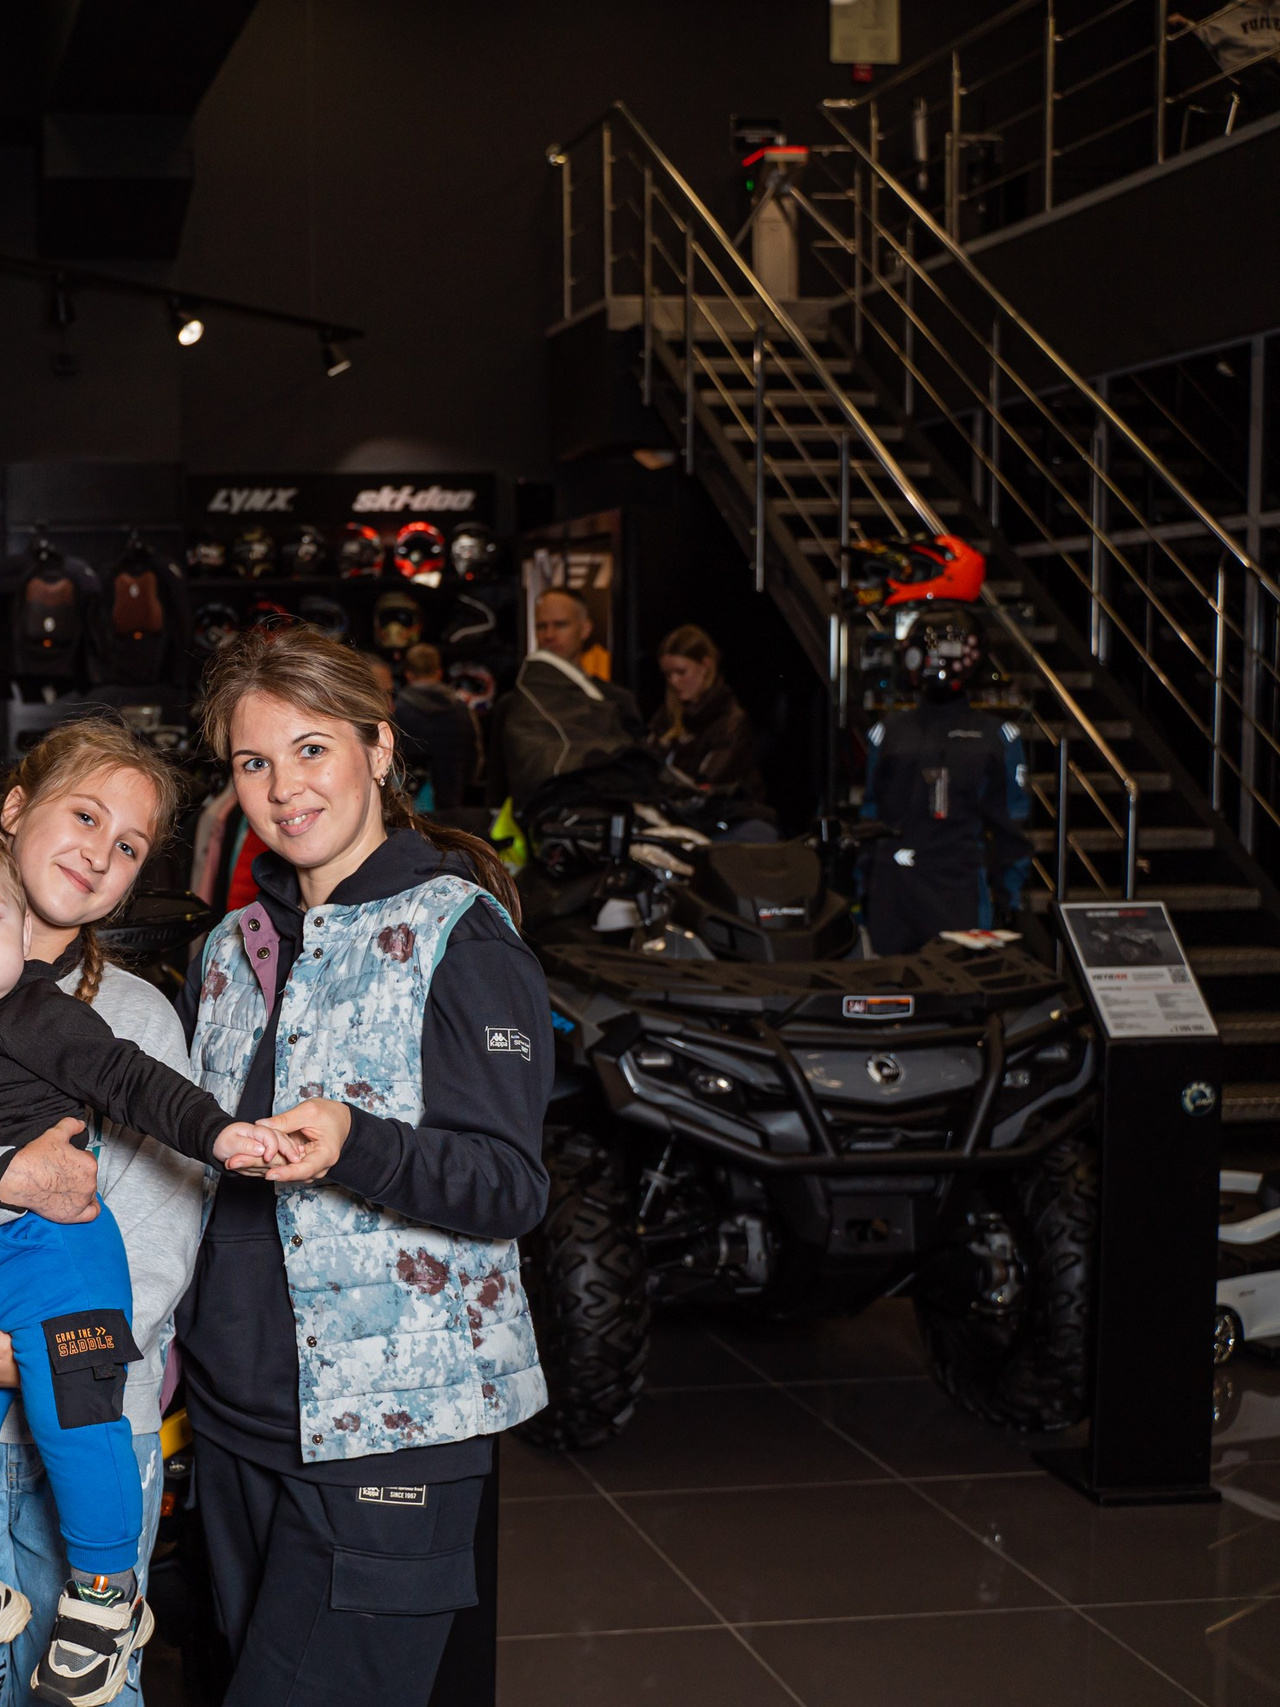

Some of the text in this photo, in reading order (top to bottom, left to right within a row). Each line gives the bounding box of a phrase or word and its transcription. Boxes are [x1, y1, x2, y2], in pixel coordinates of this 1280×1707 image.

[207, 487, 299, 515] LYNX
[352, 485, 476, 512] ski-doo
[55, 1328, 92, 1343] GRAB THE
[58, 1335, 115, 1357] SADDLE
